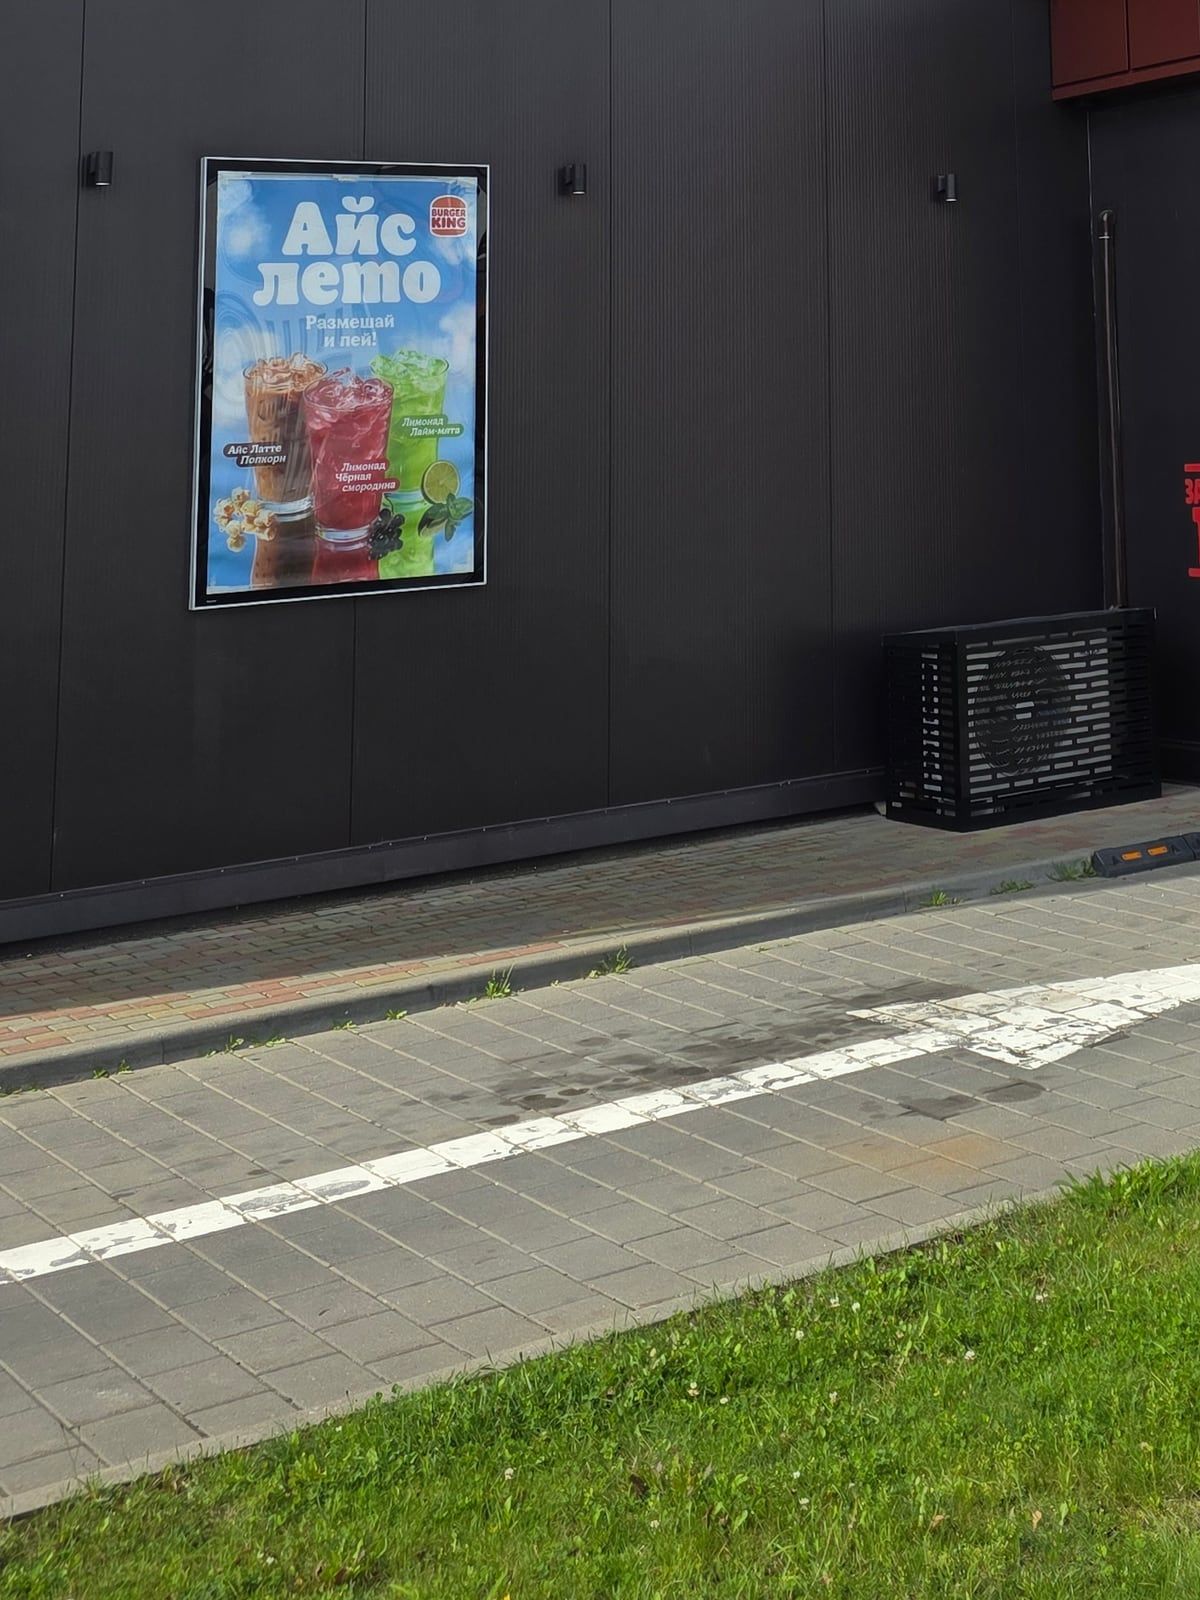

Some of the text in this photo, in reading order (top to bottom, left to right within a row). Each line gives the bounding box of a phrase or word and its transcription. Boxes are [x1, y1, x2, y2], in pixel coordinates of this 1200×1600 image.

[431, 209, 466, 217] BURGER
[282, 196, 417, 256] Айс
[431, 218, 466, 229] KING
[253, 261, 442, 306] лето
[305, 314, 395, 330] Размешай
[324, 332, 377, 347] и пей!
[402, 417, 444, 427] Лимонад
[410, 426, 460, 436] Лайм-мята
[227, 444, 282, 455] Айс Латте
[240, 455, 286, 465] Попкорн
[341, 462, 386, 472] Лимонад
[335, 472, 372, 483] Чёрная
[342, 481, 396, 493] смородина
